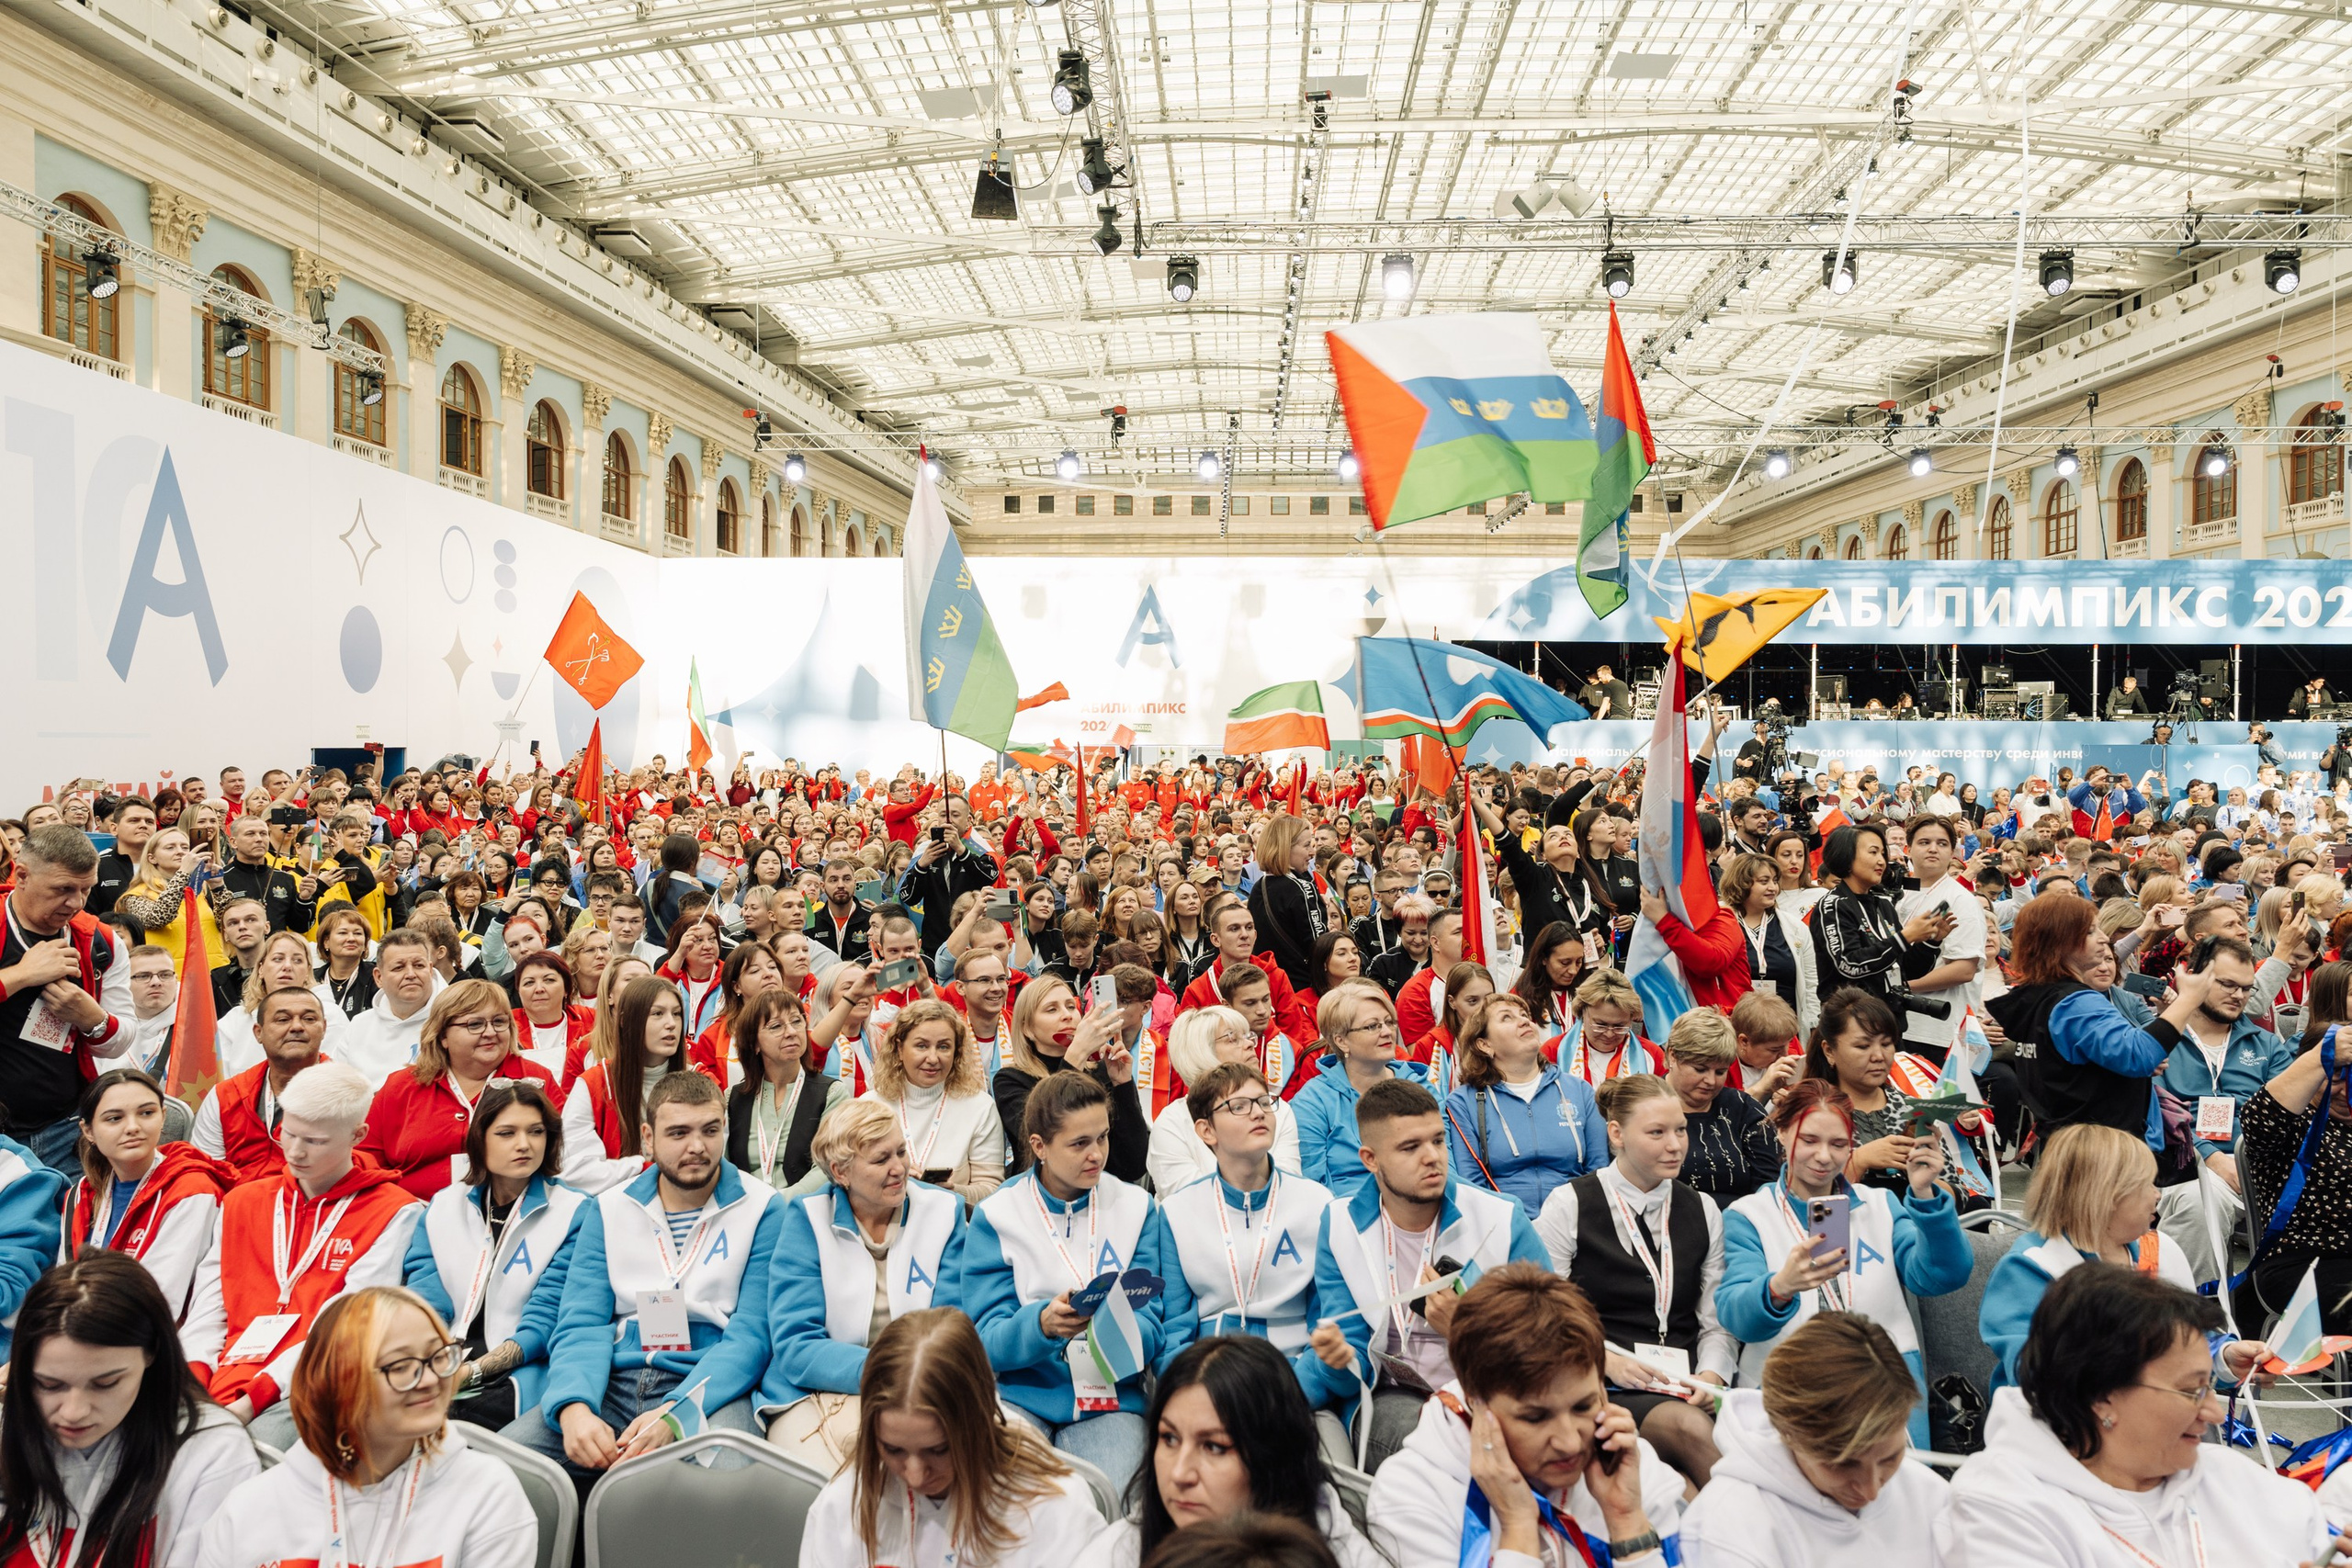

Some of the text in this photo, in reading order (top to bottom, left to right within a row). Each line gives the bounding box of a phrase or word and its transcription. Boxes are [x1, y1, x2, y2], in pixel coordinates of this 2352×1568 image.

[1806, 586, 2228, 627] АБИЛИМПИКС
[1928, 747, 2002, 761] мастерству
[2007, 748, 2050, 761] среди
